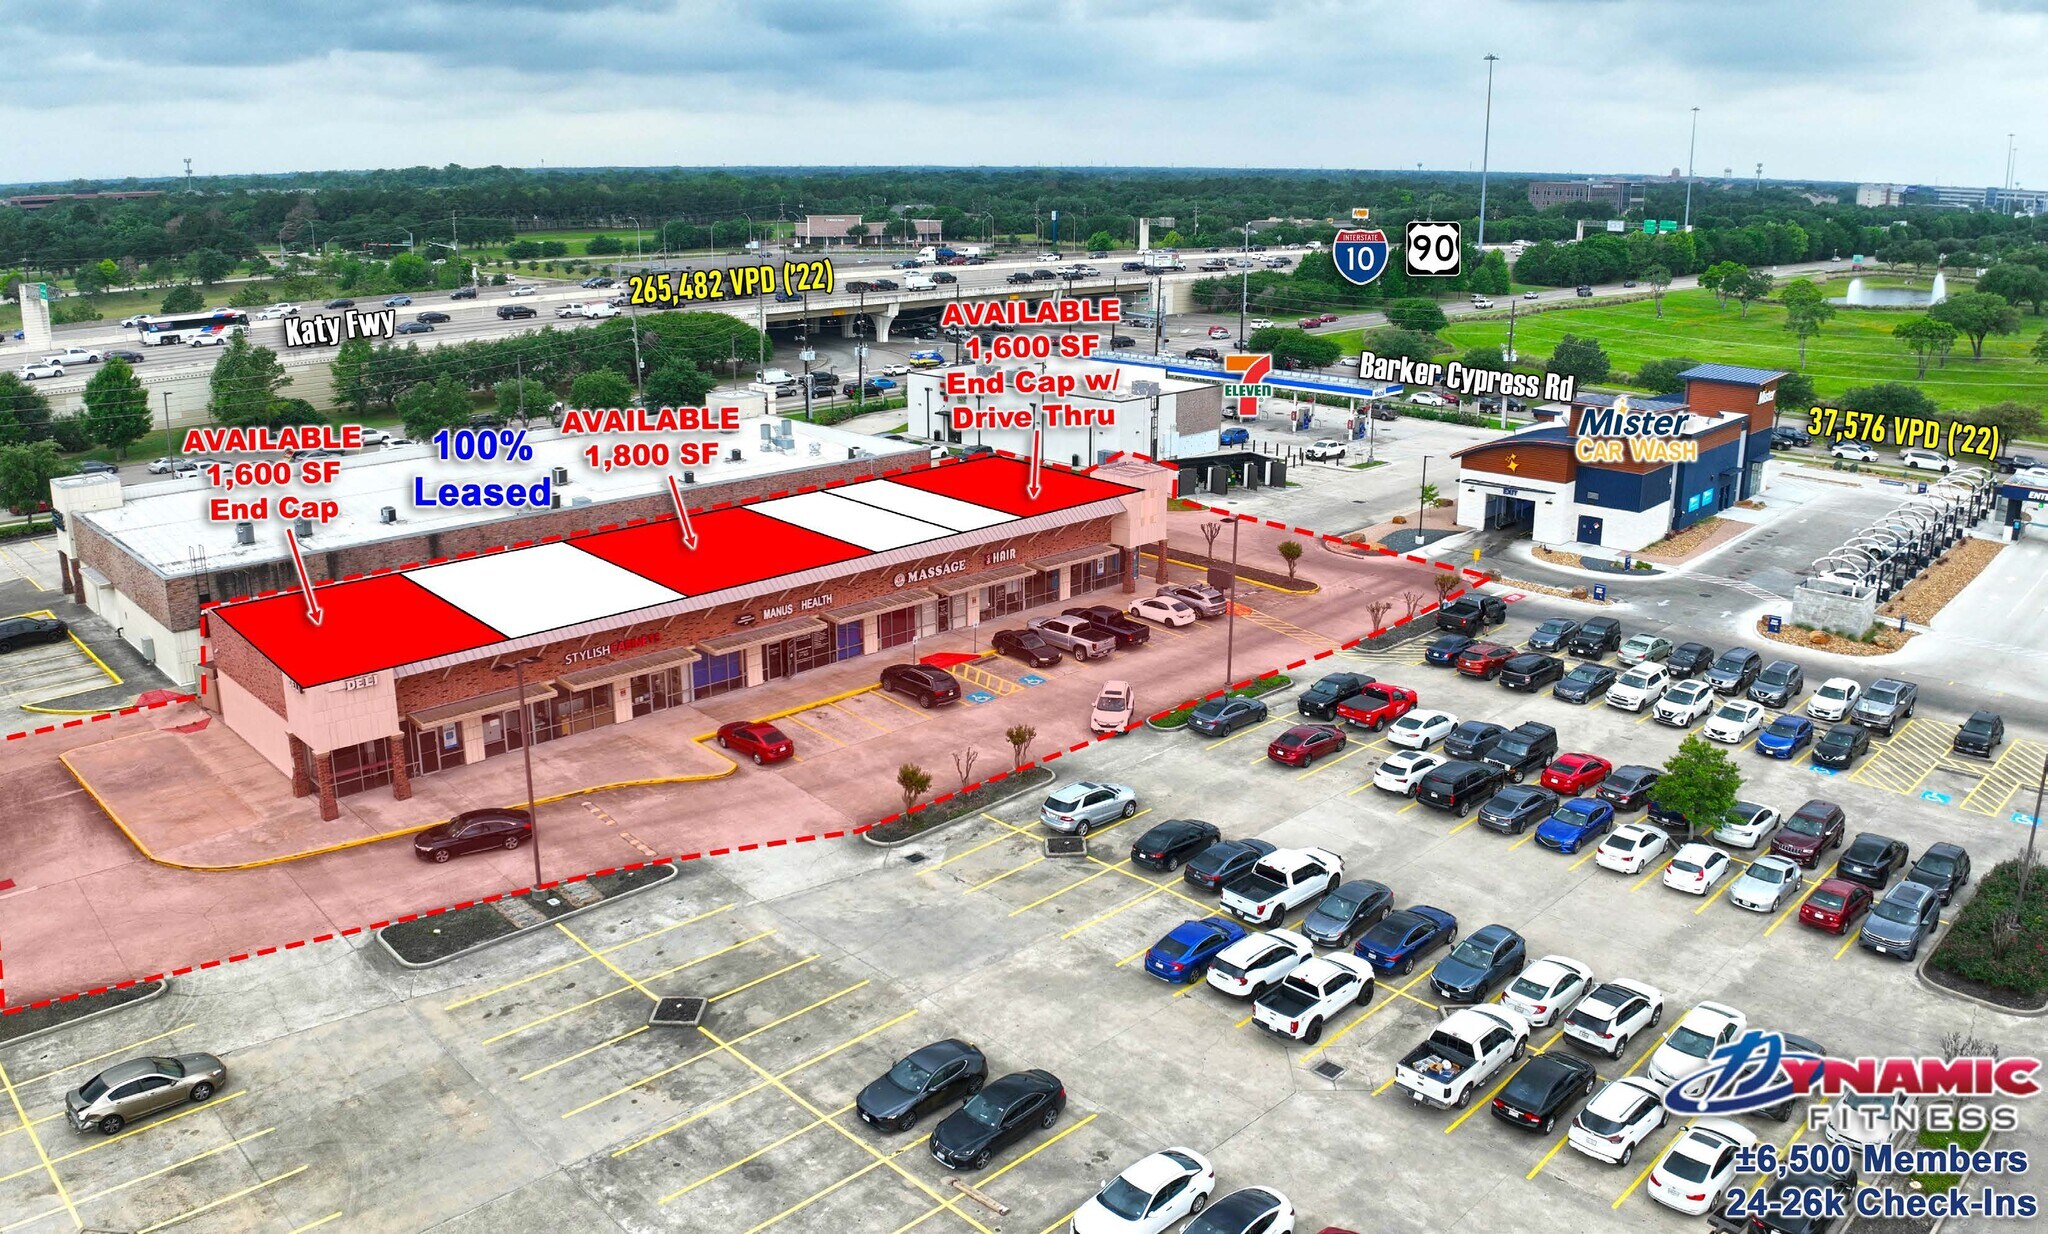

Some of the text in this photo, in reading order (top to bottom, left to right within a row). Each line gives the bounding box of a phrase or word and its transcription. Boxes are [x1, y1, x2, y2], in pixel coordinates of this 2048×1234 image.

[993, 548, 1016, 563] HAIR
[907, 559, 966, 583] MASSAGE
[763, 593, 832, 620] MANUS HEALTH
[565, 645, 611, 665] STYLISH
[345, 674, 378, 692] DELI
